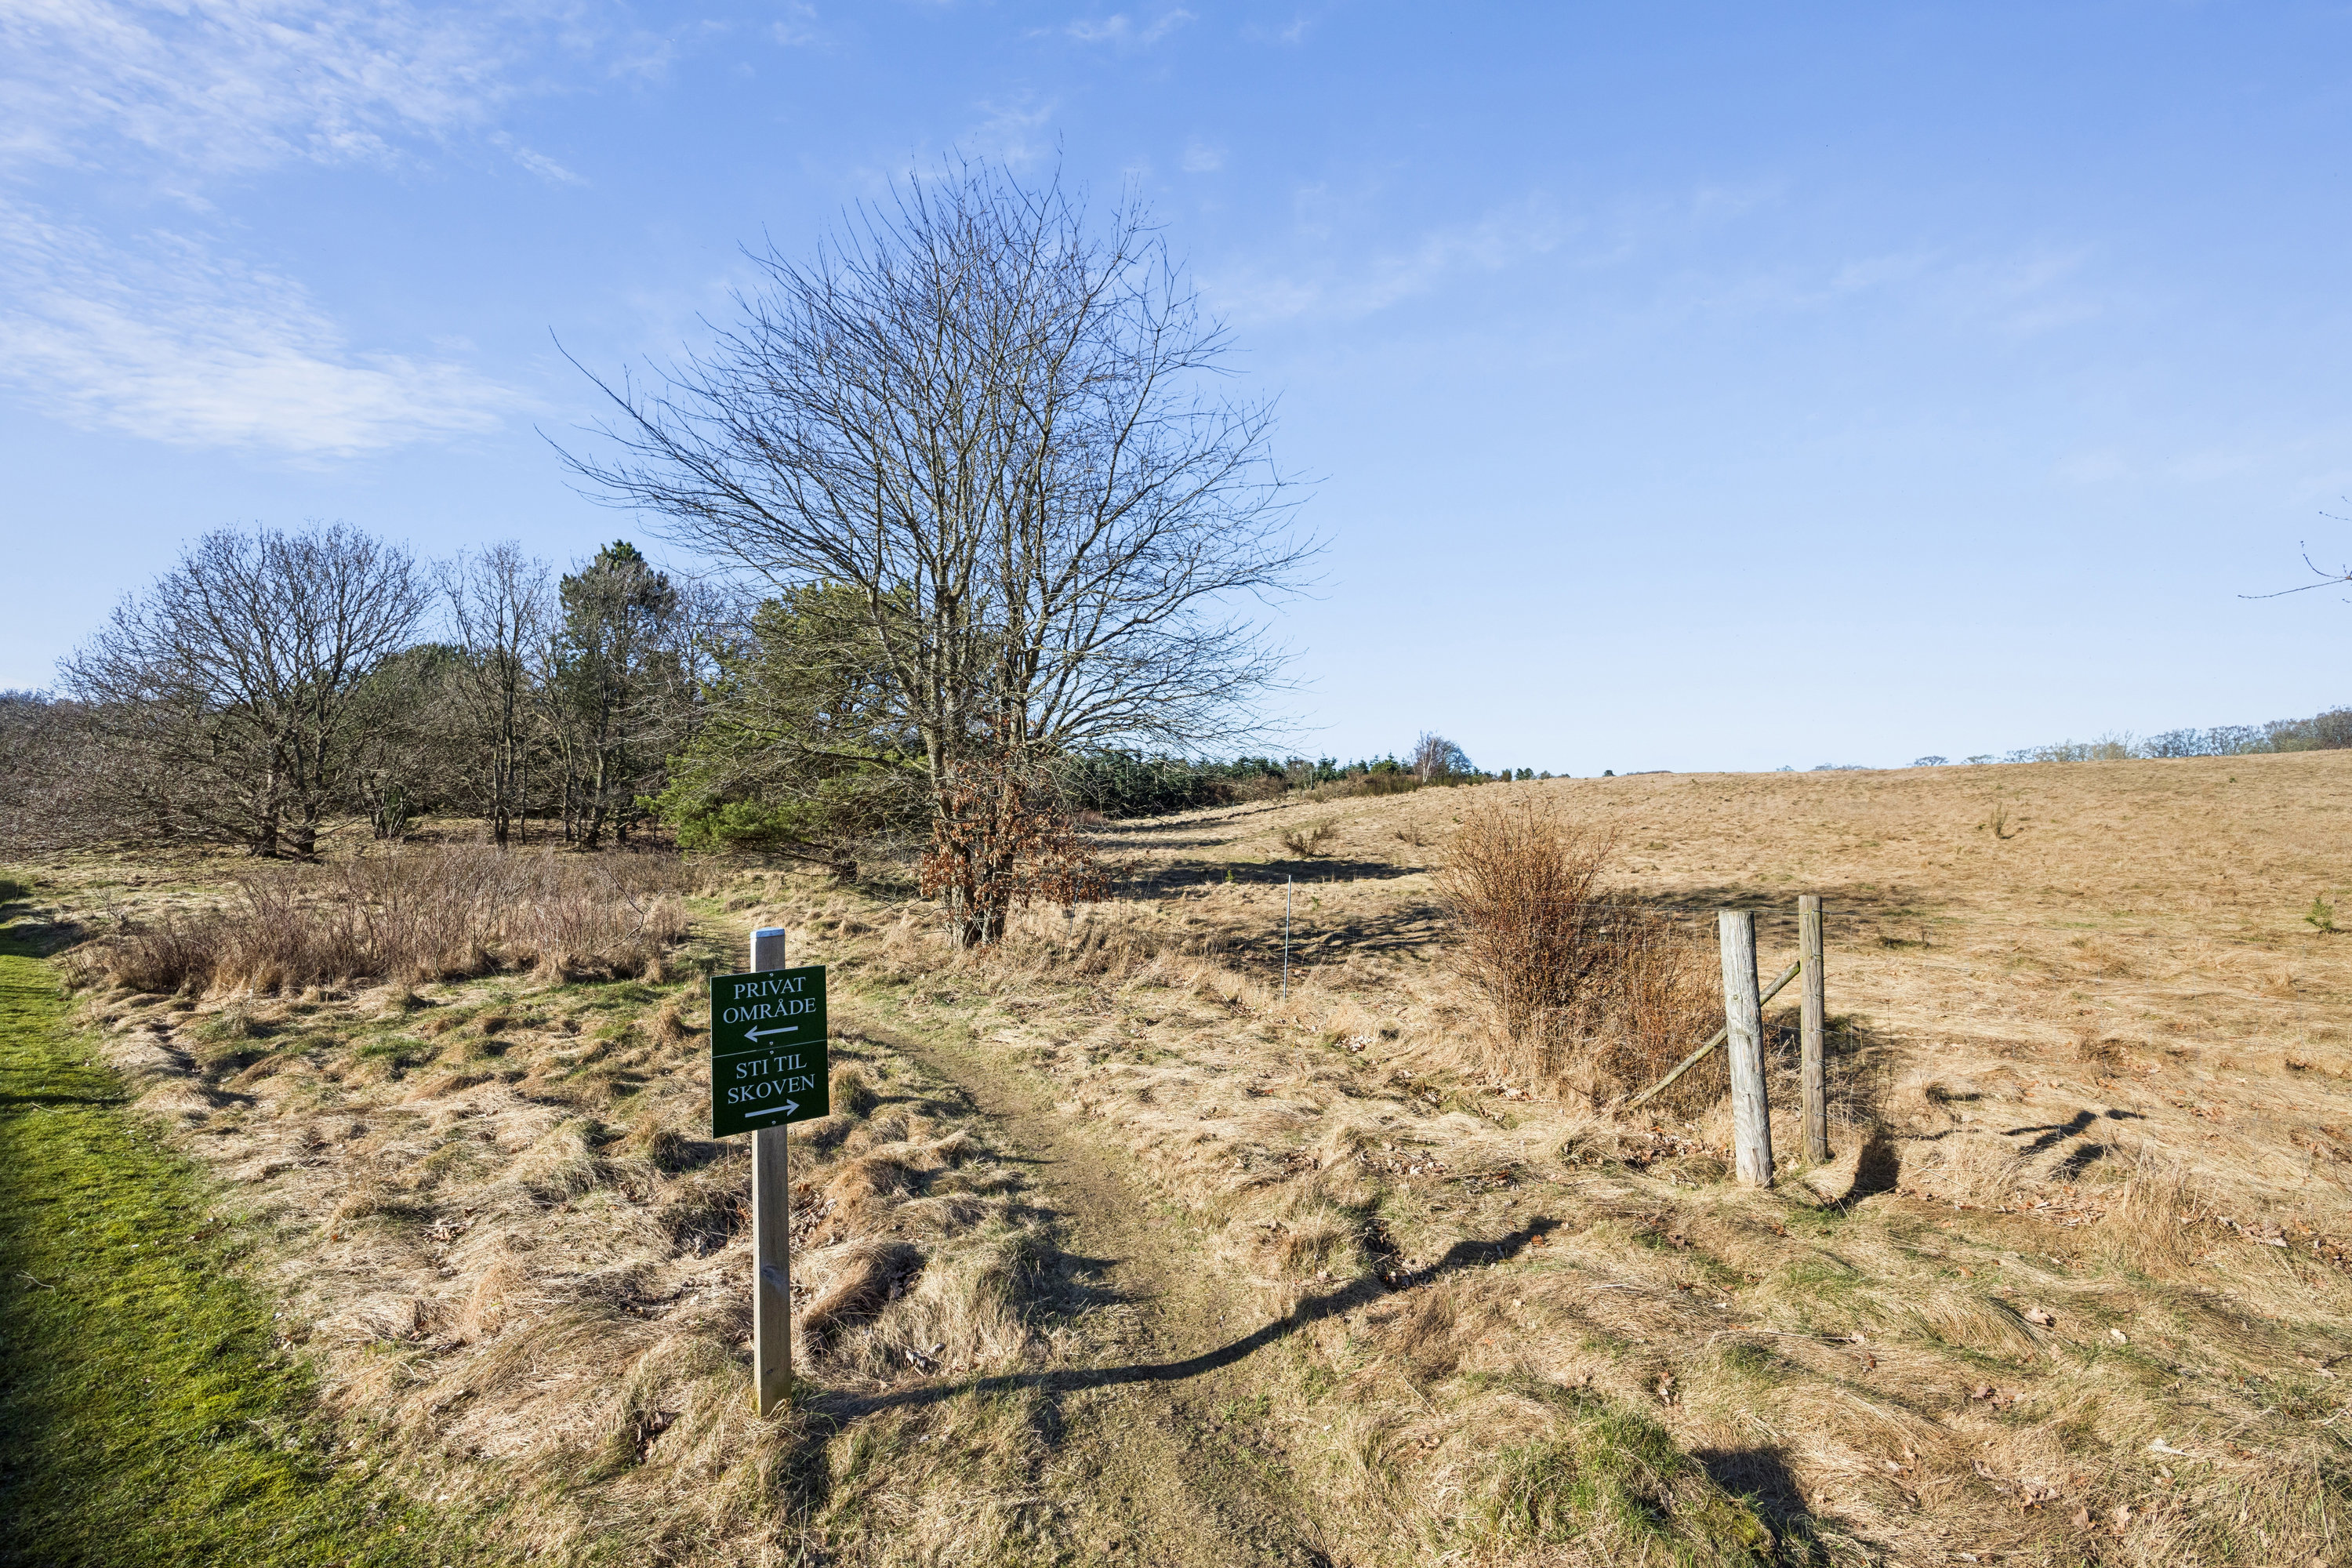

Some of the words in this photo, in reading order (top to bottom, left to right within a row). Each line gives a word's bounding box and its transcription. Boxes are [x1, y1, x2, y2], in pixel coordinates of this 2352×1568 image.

[734, 977, 806, 1000] PRIVAT
[723, 997, 817, 1024] OMRÅDE
[736, 1058, 768, 1080] STI
[774, 1054, 807, 1073] TIL
[728, 1073, 816, 1105] SKOVEN
